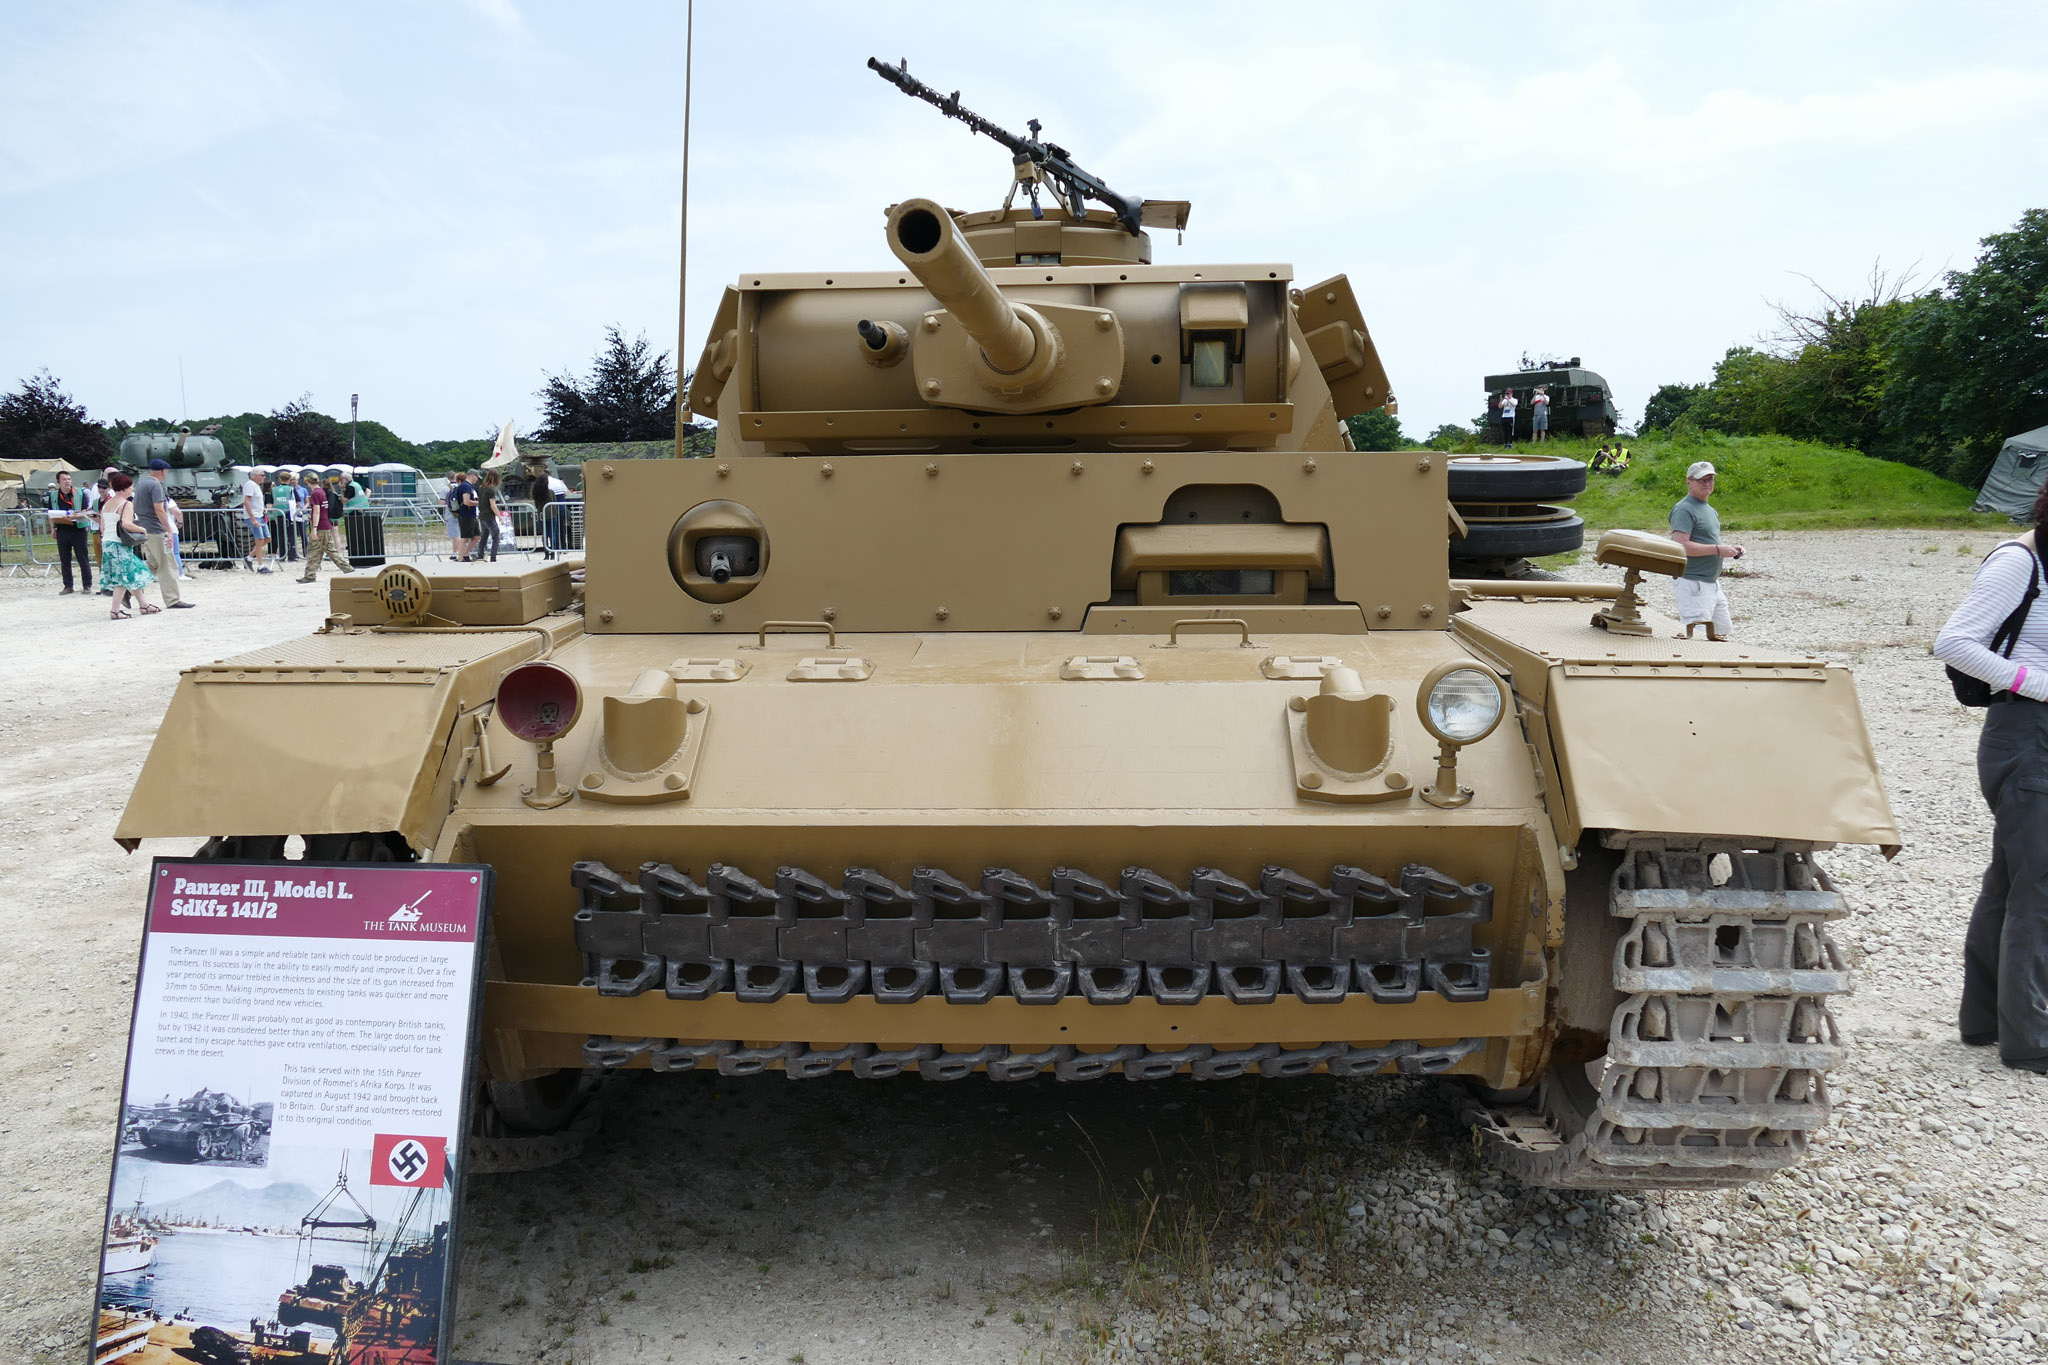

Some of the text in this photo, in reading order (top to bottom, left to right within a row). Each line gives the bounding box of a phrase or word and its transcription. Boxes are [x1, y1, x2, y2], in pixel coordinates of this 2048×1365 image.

[173, 878, 353, 900] Panzer III, Model L.
[171, 899, 277, 918] SdKfz 141/2
[364, 921, 466, 933] THE TANK MUSEUM
[170, 946, 182, 954] The
[184, 947, 208, 955] Panzer
[209, 947, 217, 955] III
[242, 950, 265, 959] simple
[267, 950, 280, 958] and
[282, 950, 308, 959] reliable
[311, 951, 326, 959] tank
[329, 952, 350, 960] which
[352, 953, 372, 961] could
[374, 953, 383, 961] be
[385, 954, 418, 963] produced
[420, 955, 427, 963] in
[430, 955, 448, 965] large
[168, 959, 200, 967] numbers.
[203, 959, 211, 967] Its
[242, 961, 252, 970] lay
[253, 961, 261, 969] in
[264, 961, 275, 969] the
[277, 962, 300, 972] ability
[301, 963, 309, 971] to
[311, 964, 332, 973] easily
[334, 964, 359, 974] modify
[360, 965, 374, 973] and
[376, 965, 405, 975] improve
[417, 967, 434, 975] Over
[443, 967, 456, 976] five
[167, 971, 182, 979] year
[184, 971, 206, 980] period
[208, 971, 216, 979] its
[246, 973, 271, 981] trebled
[283, 974, 315, 983] thickness
[317, 975, 331, 983] and
[333, 976, 345, 984] the
[347, 977, 360, 985] size
[363, 977, 371, 985] of
[373, 977, 381, 986] its
[384, 979, 397, 987] gun
[400, 978, 434, 987] increased
[437, 979, 453, 988] from
[165, 982, 187, 990] 37mm
[199, 983, 223, 991] 50mm.
[226, 984, 252, 995] Making
[254, 987, 305, 995] improvements
[306, 987, 314, 995] to
[317, 988, 345, 998] existing
[347, 989, 366, 997] tanks
[385, 991, 412, 1000] quicker
[414, 991, 427, 999] and
[163, 995, 202, 1003] convenient
[204, 995, 220, 1003] than
[223, 996, 251, 1007] building
[254, 997, 274, 1006] brand
[294, 999, 323, 1007] vehicles.
[159, 1010, 167, 1018] In
[171, 1011, 189, 1020] 1940,
[192, 1012, 203, 1020] the
[206, 1012, 230, 1021] Panzer
[231, 1013, 239, 1021] III
[257, 1015, 289, 1024] probably
[291, 1016, 303, 1024] not
[315, 1017, 333, 1026] good
[345, 1019, 396, 1029] contemporary
[398, 1019, 422, 1028] British
[425, 1021, 445, 1030] tanks,
[158, 1022, 170, 1030] but
[172, 1023, 181, 1032] by
[184, 1024, 201, 1032] 1942
[203, 1024, 209, 1032] it
[212, 1025, 225, 1033] was
[227, 1026, 266, 1034] considered
[269, 1027, 291, 1035] better
[293, 1028, 309, 1036] than
[311, 1030, 325, 1038] any
[327, 1029, 335, 1037] of
[337, 1030, 356, 1038] them.
[360, 1030, 372, 1039] The
[374, 1031, 392, 1041] large
[395, 1032, 415, 1040] doors
[429, 1033, 440, 1041] the
[155, 1047, 224, 1057] crews in the desert.
[157, 1035, 442, 1054] turret and tiny escape hatches gave extra ventilation, especially useful for tank
[284, 1064, 421, 1078] This tank served with the 15th Panzer
[283, 1076, 310, 1085] Division
[313, 1078, 321, 1086] of
[360, 1080, 382, 1088] Afrika
[384, 1081, 406, 1091] Korps.
[408, 1082, 415, 1090] It
[417, 1083, 431, 1091] was
[281, 1090, 438, 1104] captured in August 1942 and brought back
[279, 1101, 442, 1117] to Britain. Our staff and volunteers restored
[277, 1114, 373, 1126] it to its original condition.
